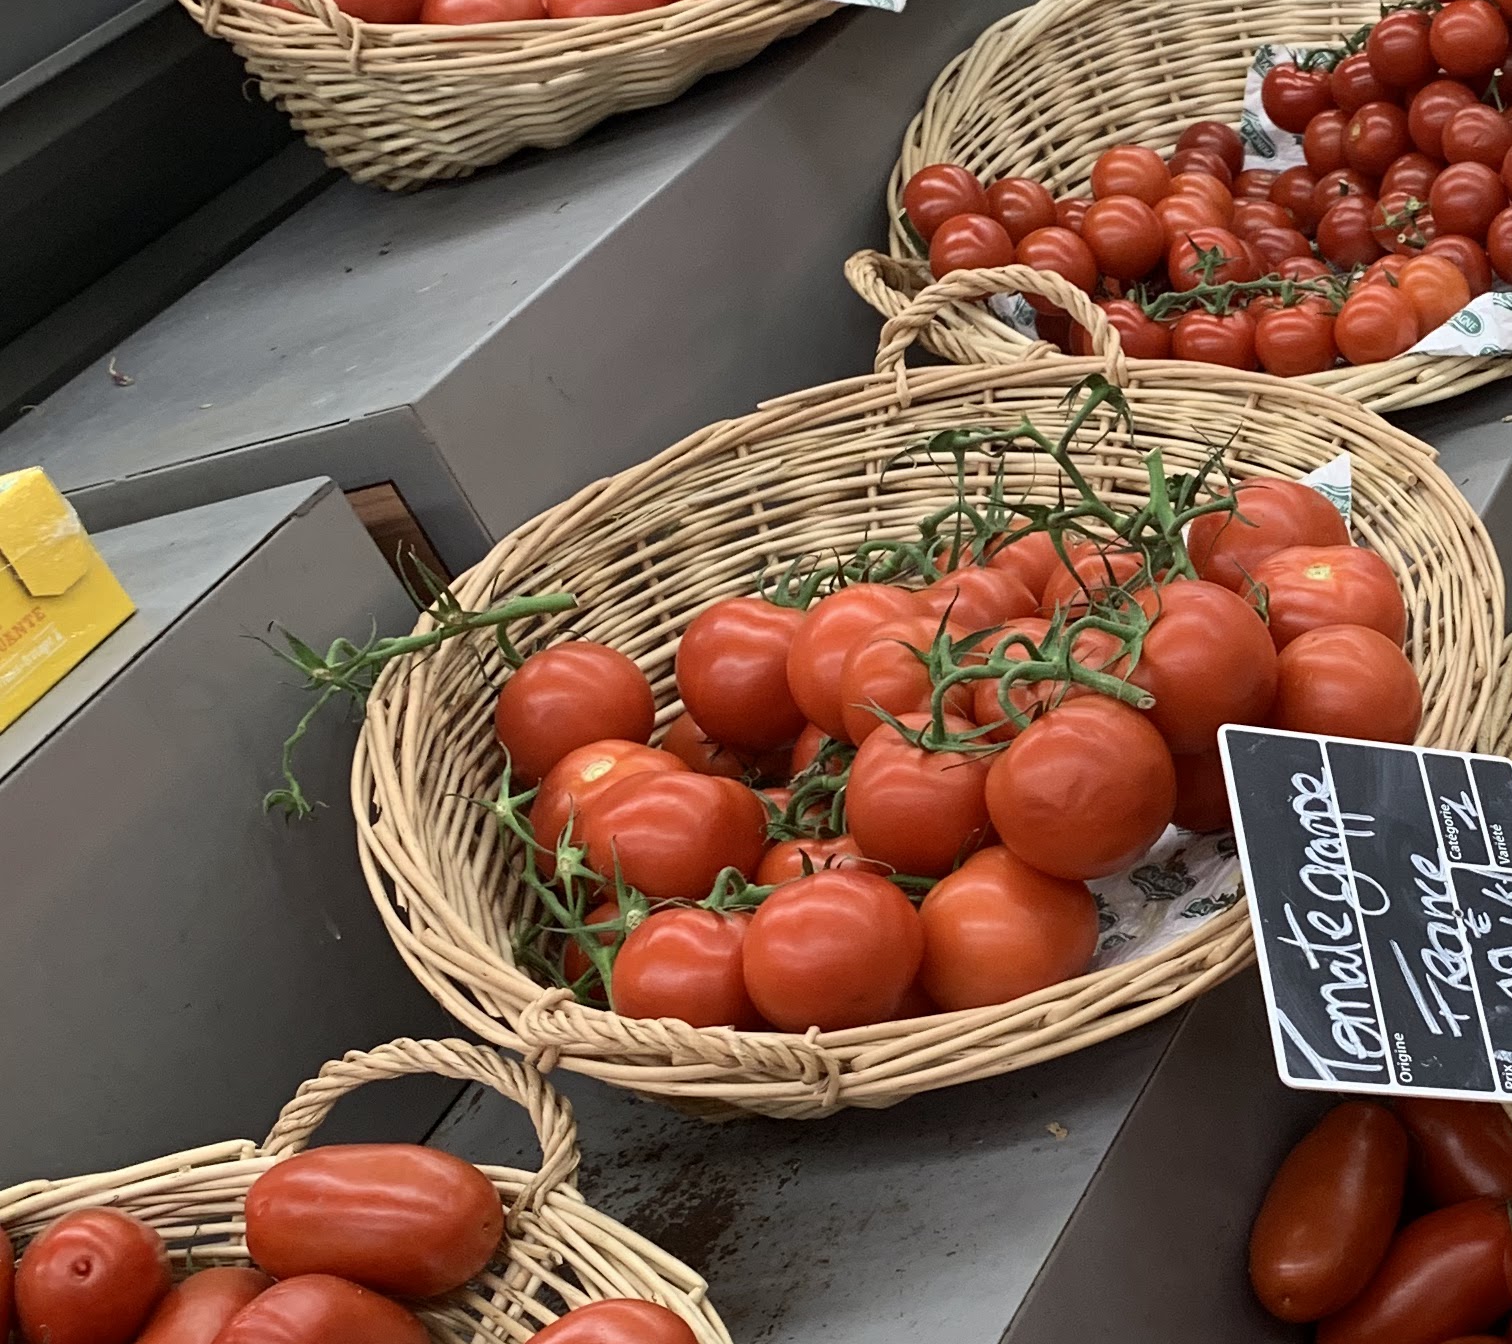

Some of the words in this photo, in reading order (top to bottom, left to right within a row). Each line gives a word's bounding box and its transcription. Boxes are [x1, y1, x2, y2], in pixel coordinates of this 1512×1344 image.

[1440, 801, 1462, 862] Catégorie
[1491, 821, 1510, 865] Variété
[1276, 902, 1384, 1082] Tomate
[1399, 1031, 1414, 1084] Origine
